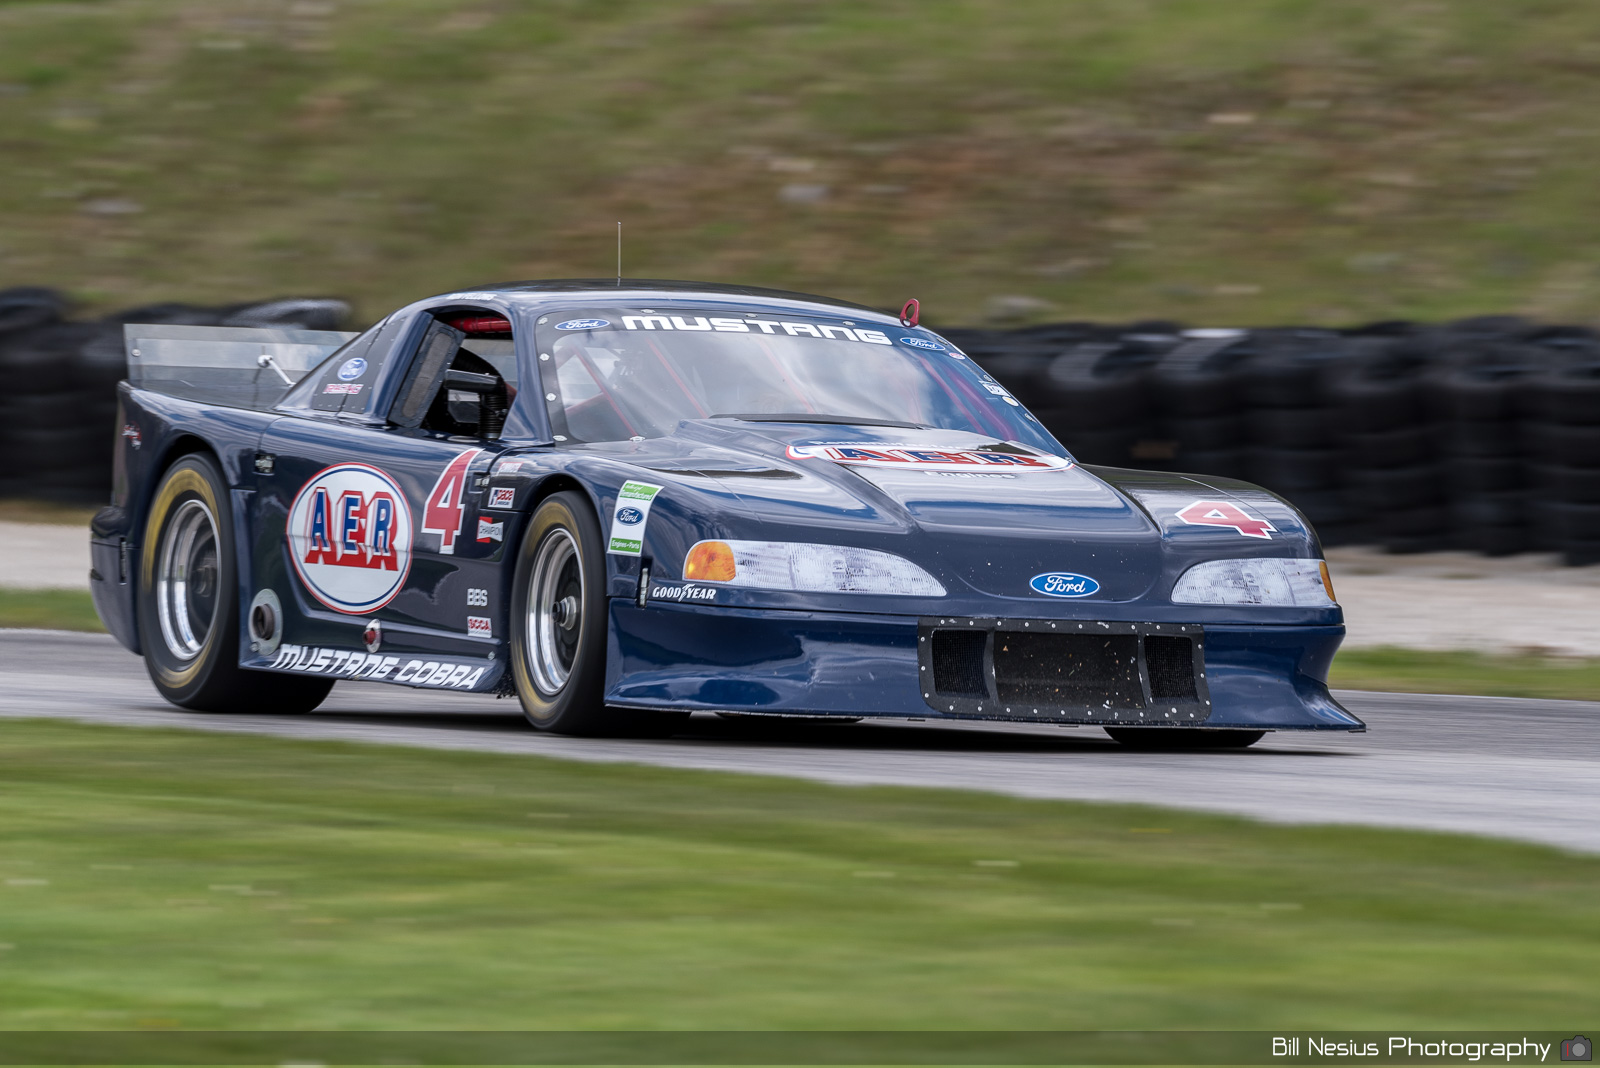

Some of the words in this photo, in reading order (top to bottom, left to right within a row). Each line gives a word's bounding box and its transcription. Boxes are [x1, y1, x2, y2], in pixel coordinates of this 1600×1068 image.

[621, 315, 893, 346] MUSTANG
[824, 447, 1053, 468] AER
[923, 470, 1016, 480] Engines
[421, 447, 486, 555] 4
[619, 509, 640, 523] Ford
[1175, 500, 1278, 541] 4
[305, 487, 399, 571] AER
[652, 584, 717, 602] GOODYEAR
[1043, 575, 1087, 594] Ford
[467, 588, 488, 606] BBS
[468, 618, 491, 631] SCCA
[270, 643, 401, 679] MUSTANG
[393, 659, 485, 690] COBRA
